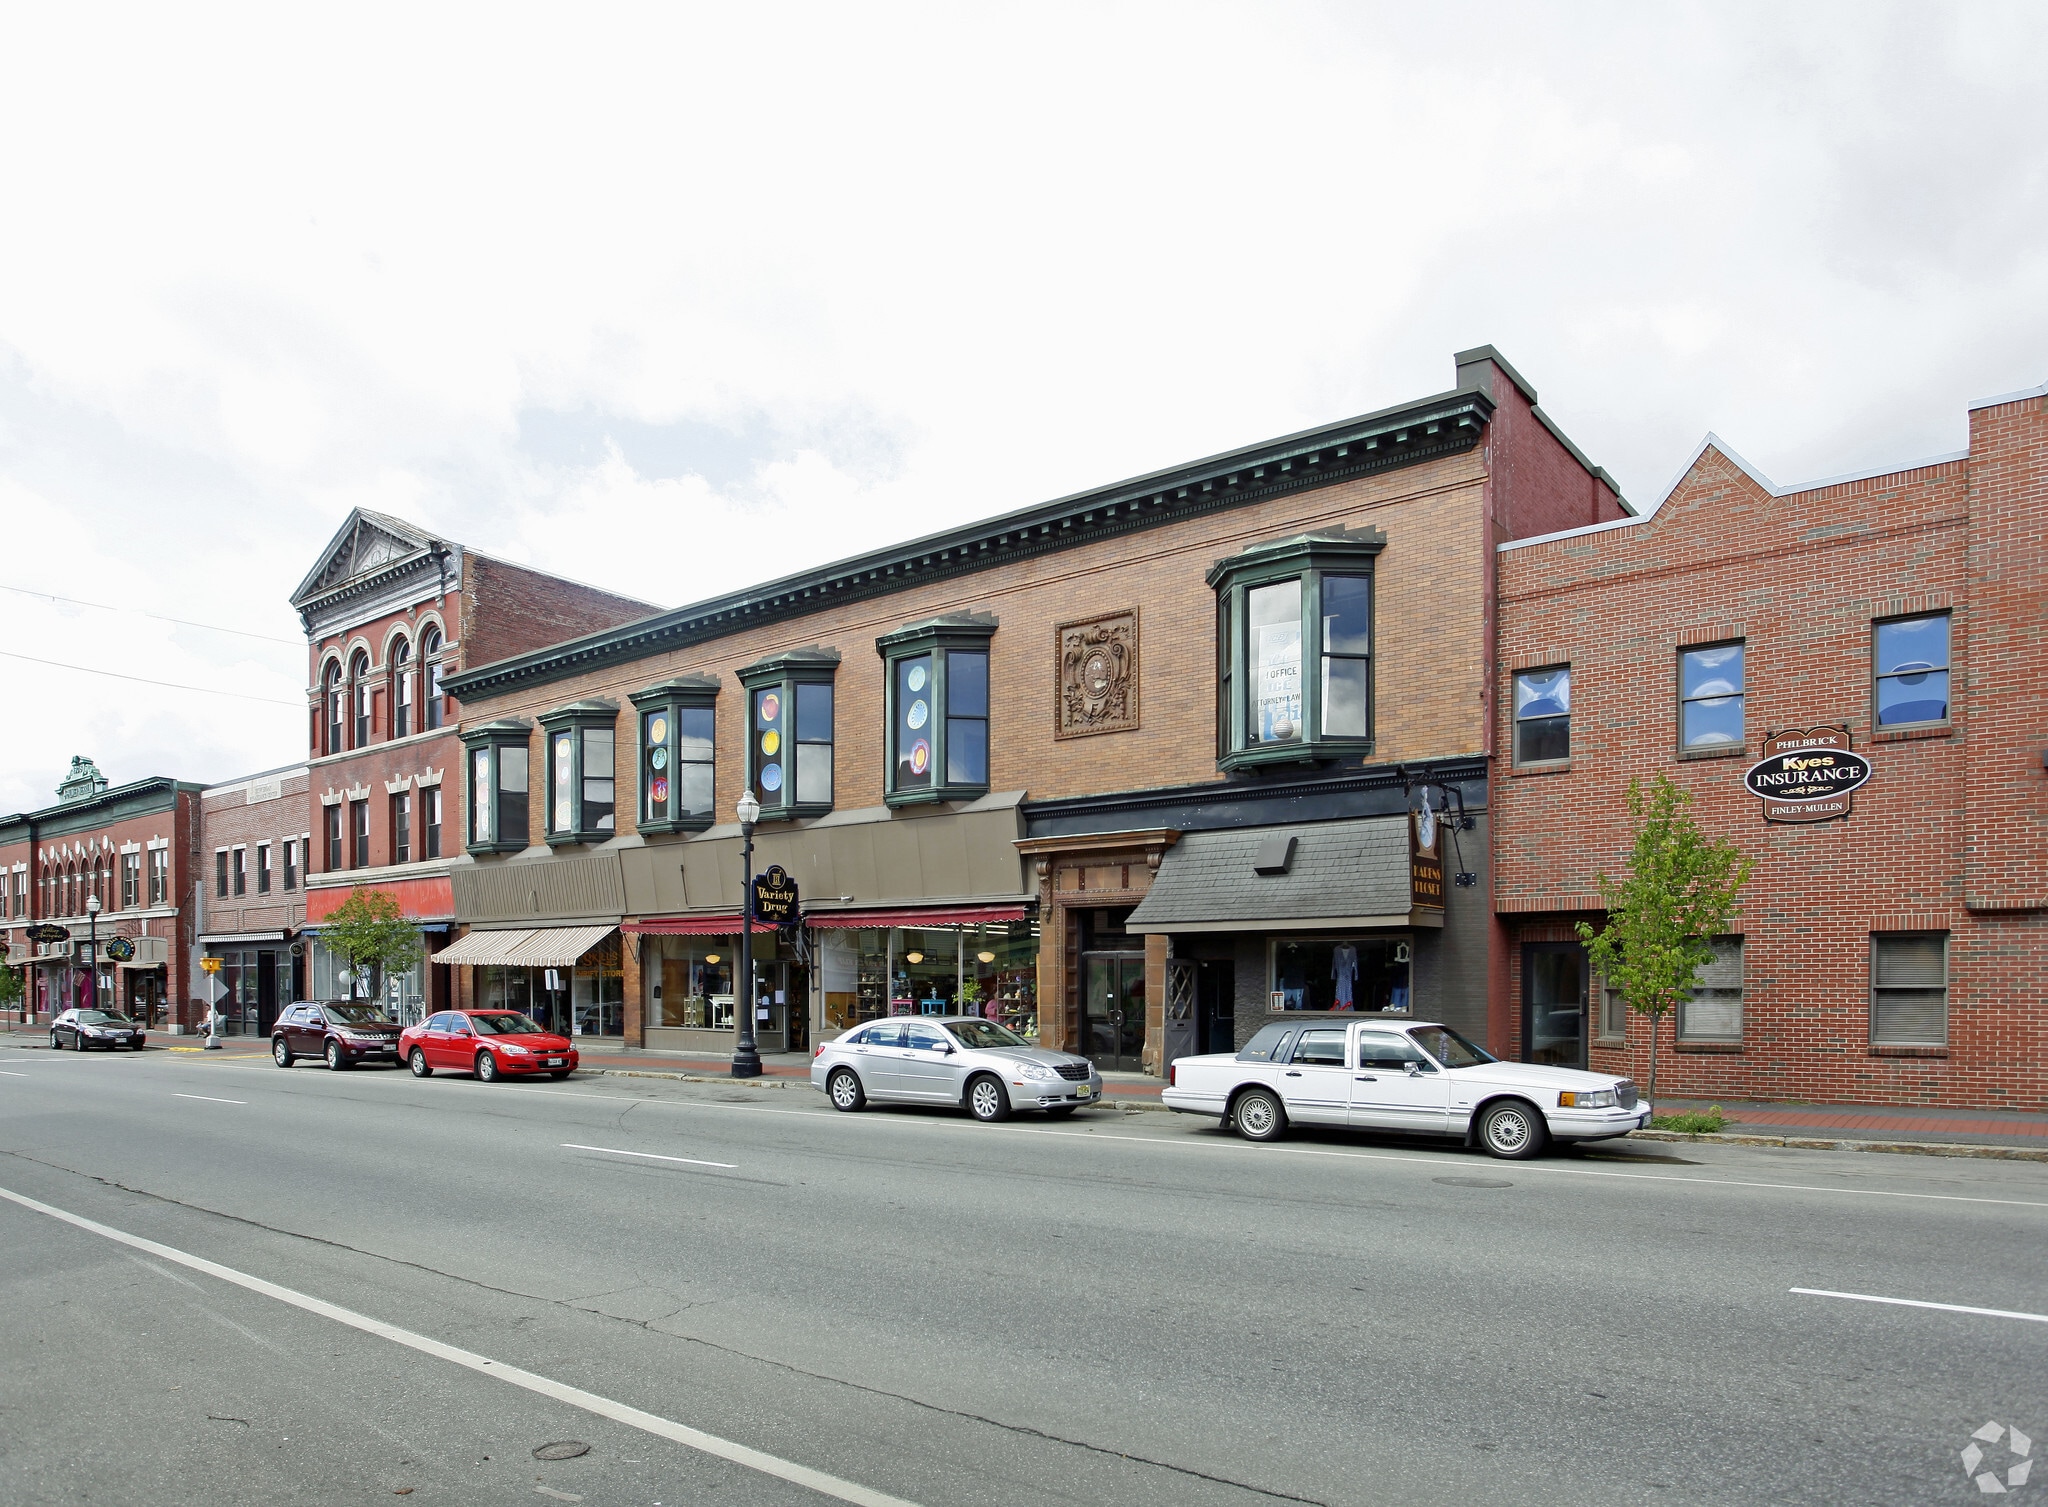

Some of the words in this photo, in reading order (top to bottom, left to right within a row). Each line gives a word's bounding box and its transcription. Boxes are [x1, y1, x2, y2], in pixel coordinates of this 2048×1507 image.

[1270, 666, 1297, 679] OFFICE
[1776, 736, 1838, 749] PHILBRICK
[1782, 756, 1835, 771] Kyes
[1755, 765, 1861, 787] INSURANCE
[1771, 802, 1843, 815] FINLEY-MULLEN
[756, 885, 794, 903] Variety
[762, 901, 788, 914] Drug
